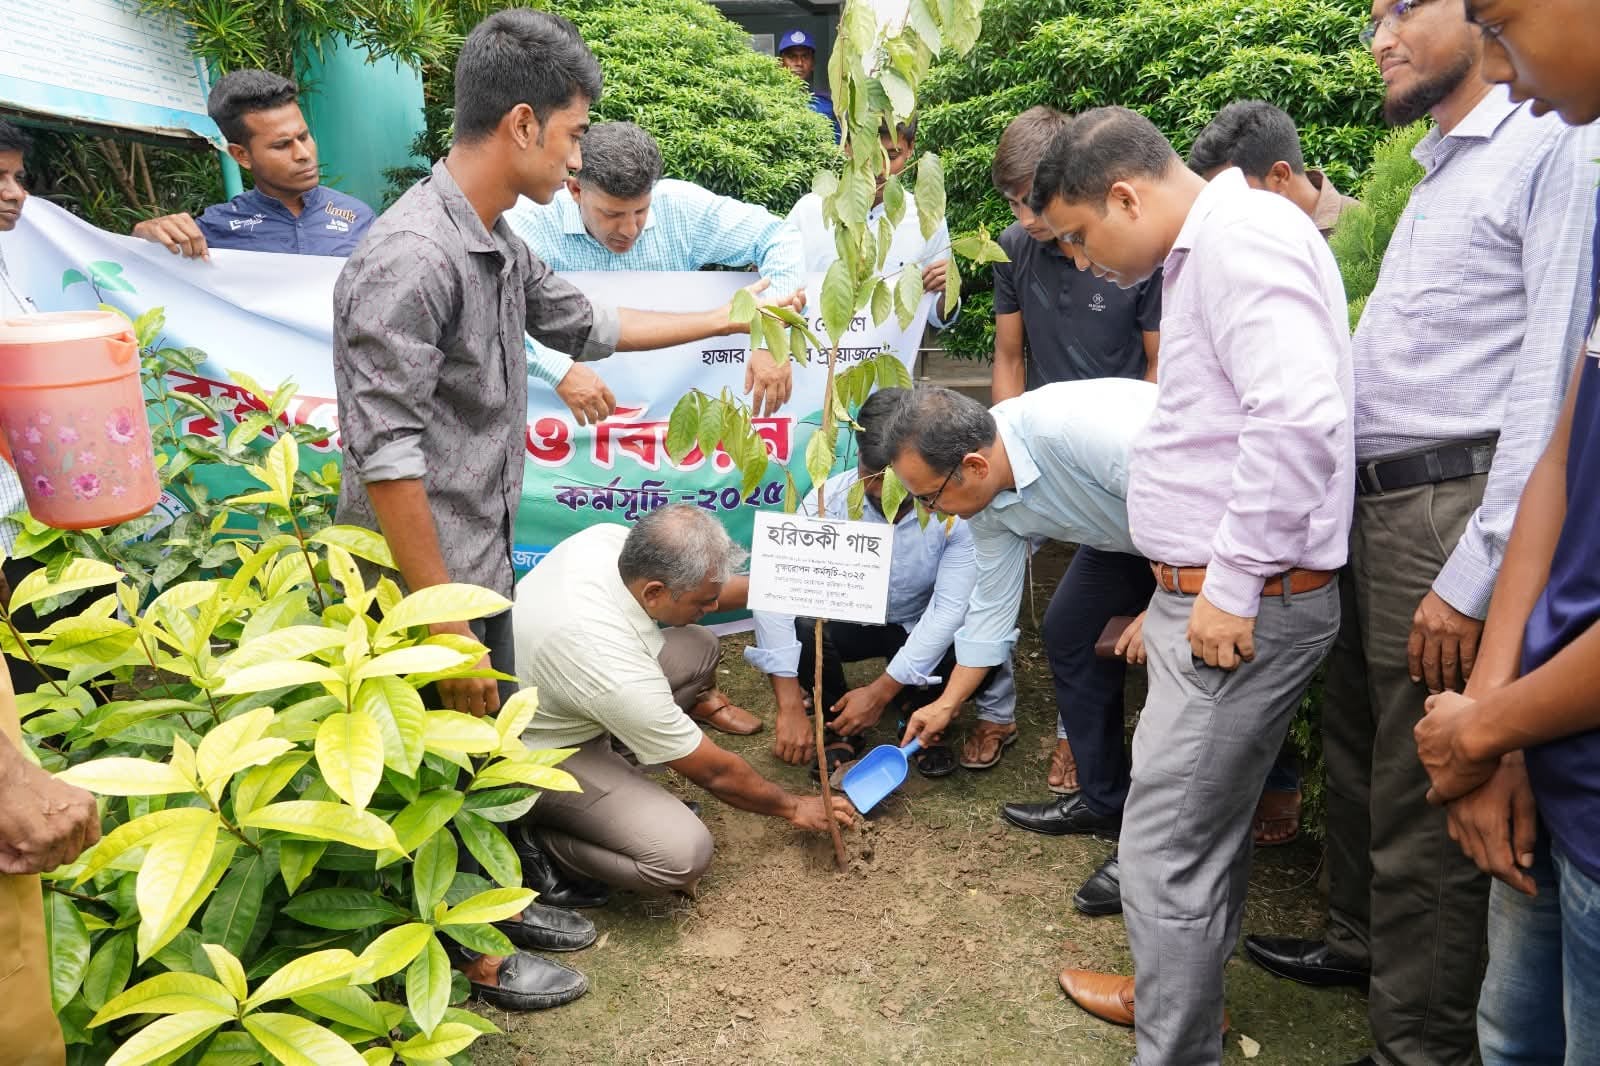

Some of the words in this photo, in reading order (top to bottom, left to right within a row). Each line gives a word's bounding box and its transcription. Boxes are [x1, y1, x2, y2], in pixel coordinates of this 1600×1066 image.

[701, 348, 746, 365] হাজার
[526, 416, 574, 464] ও
[553, 476, 672, 522] কর্মসূচি
[766, 521, 840, 551] হরিতকী
[846, 533, 882, 557] গাছ
